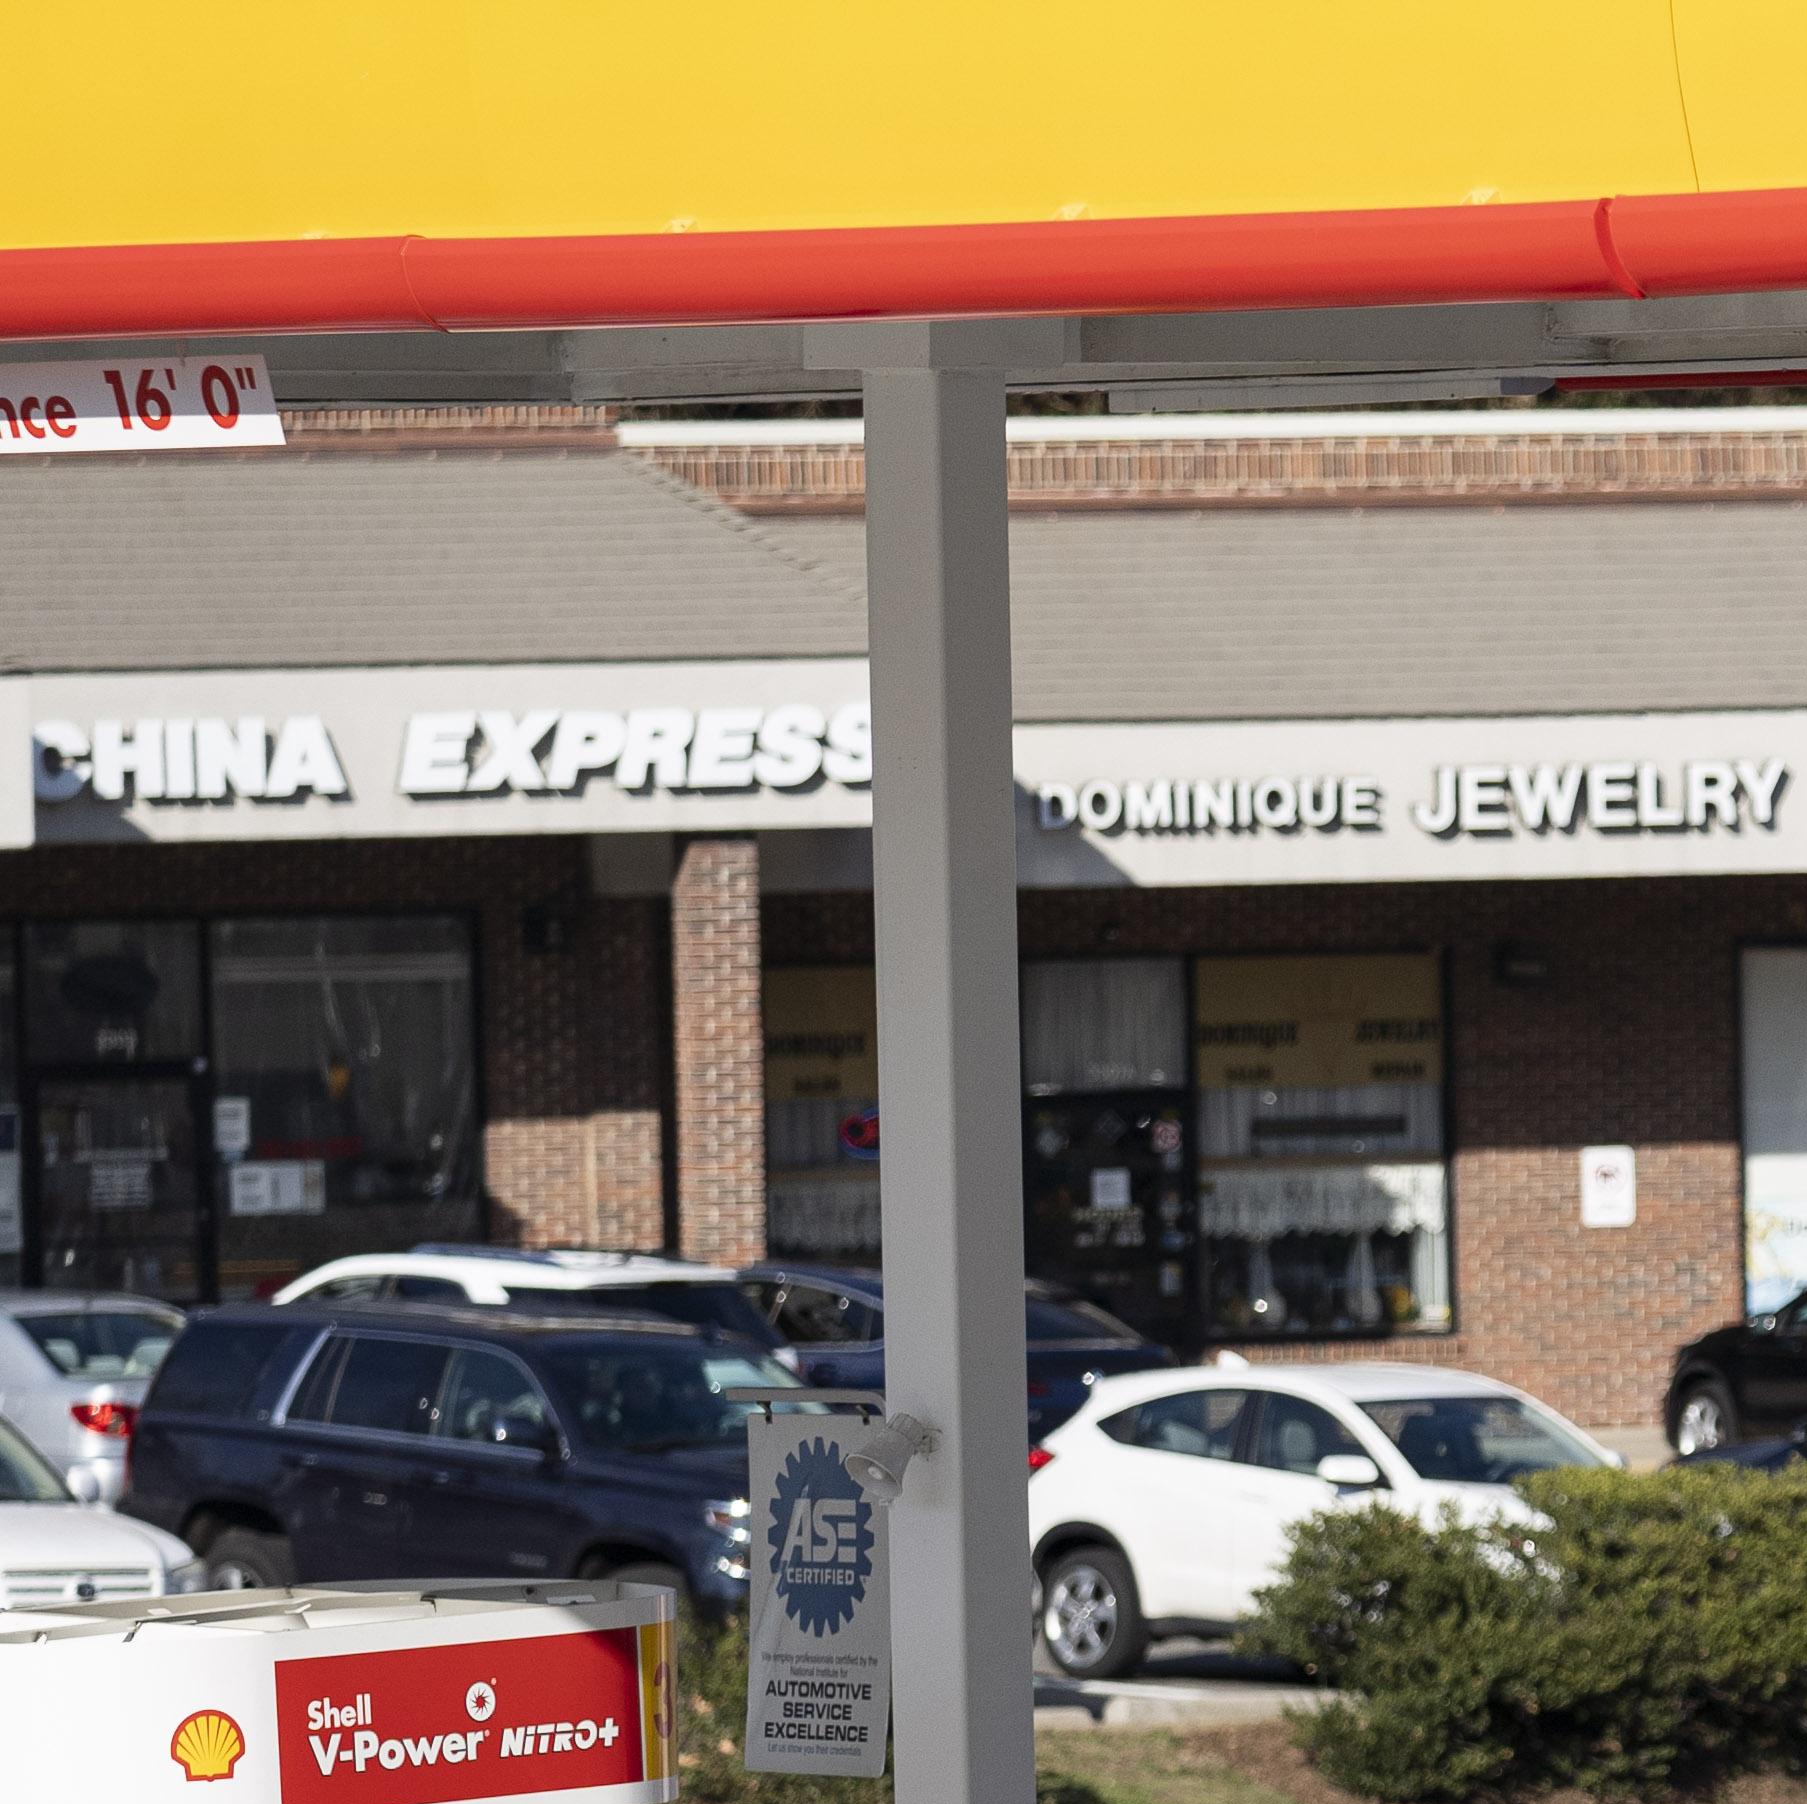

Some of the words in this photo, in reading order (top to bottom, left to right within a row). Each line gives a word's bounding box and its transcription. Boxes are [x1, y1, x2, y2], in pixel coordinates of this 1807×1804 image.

[103, 368, 176, 431] 16'
[34, 714, 350, 802] CHINA
[399, 706, 872, 798] EXPRESS
[1039, 778, 1384, 837] DOMINIQUE
[1416, 759, 1789, 836] JEWELRY
[781, 1494, 857, 1564] ASE
[786, 1567, 855, 1586] CERTIFIED
[765, 1680, 873, 1701] AUTOMOTIVE
[783, 1701, 853, 1721] SERVICE
[307, 1693, 372, 1731] Shell
[764, 1722, 869, 1743] EXCELLENCE
[308, 1729, 486, 1776] V-Power
